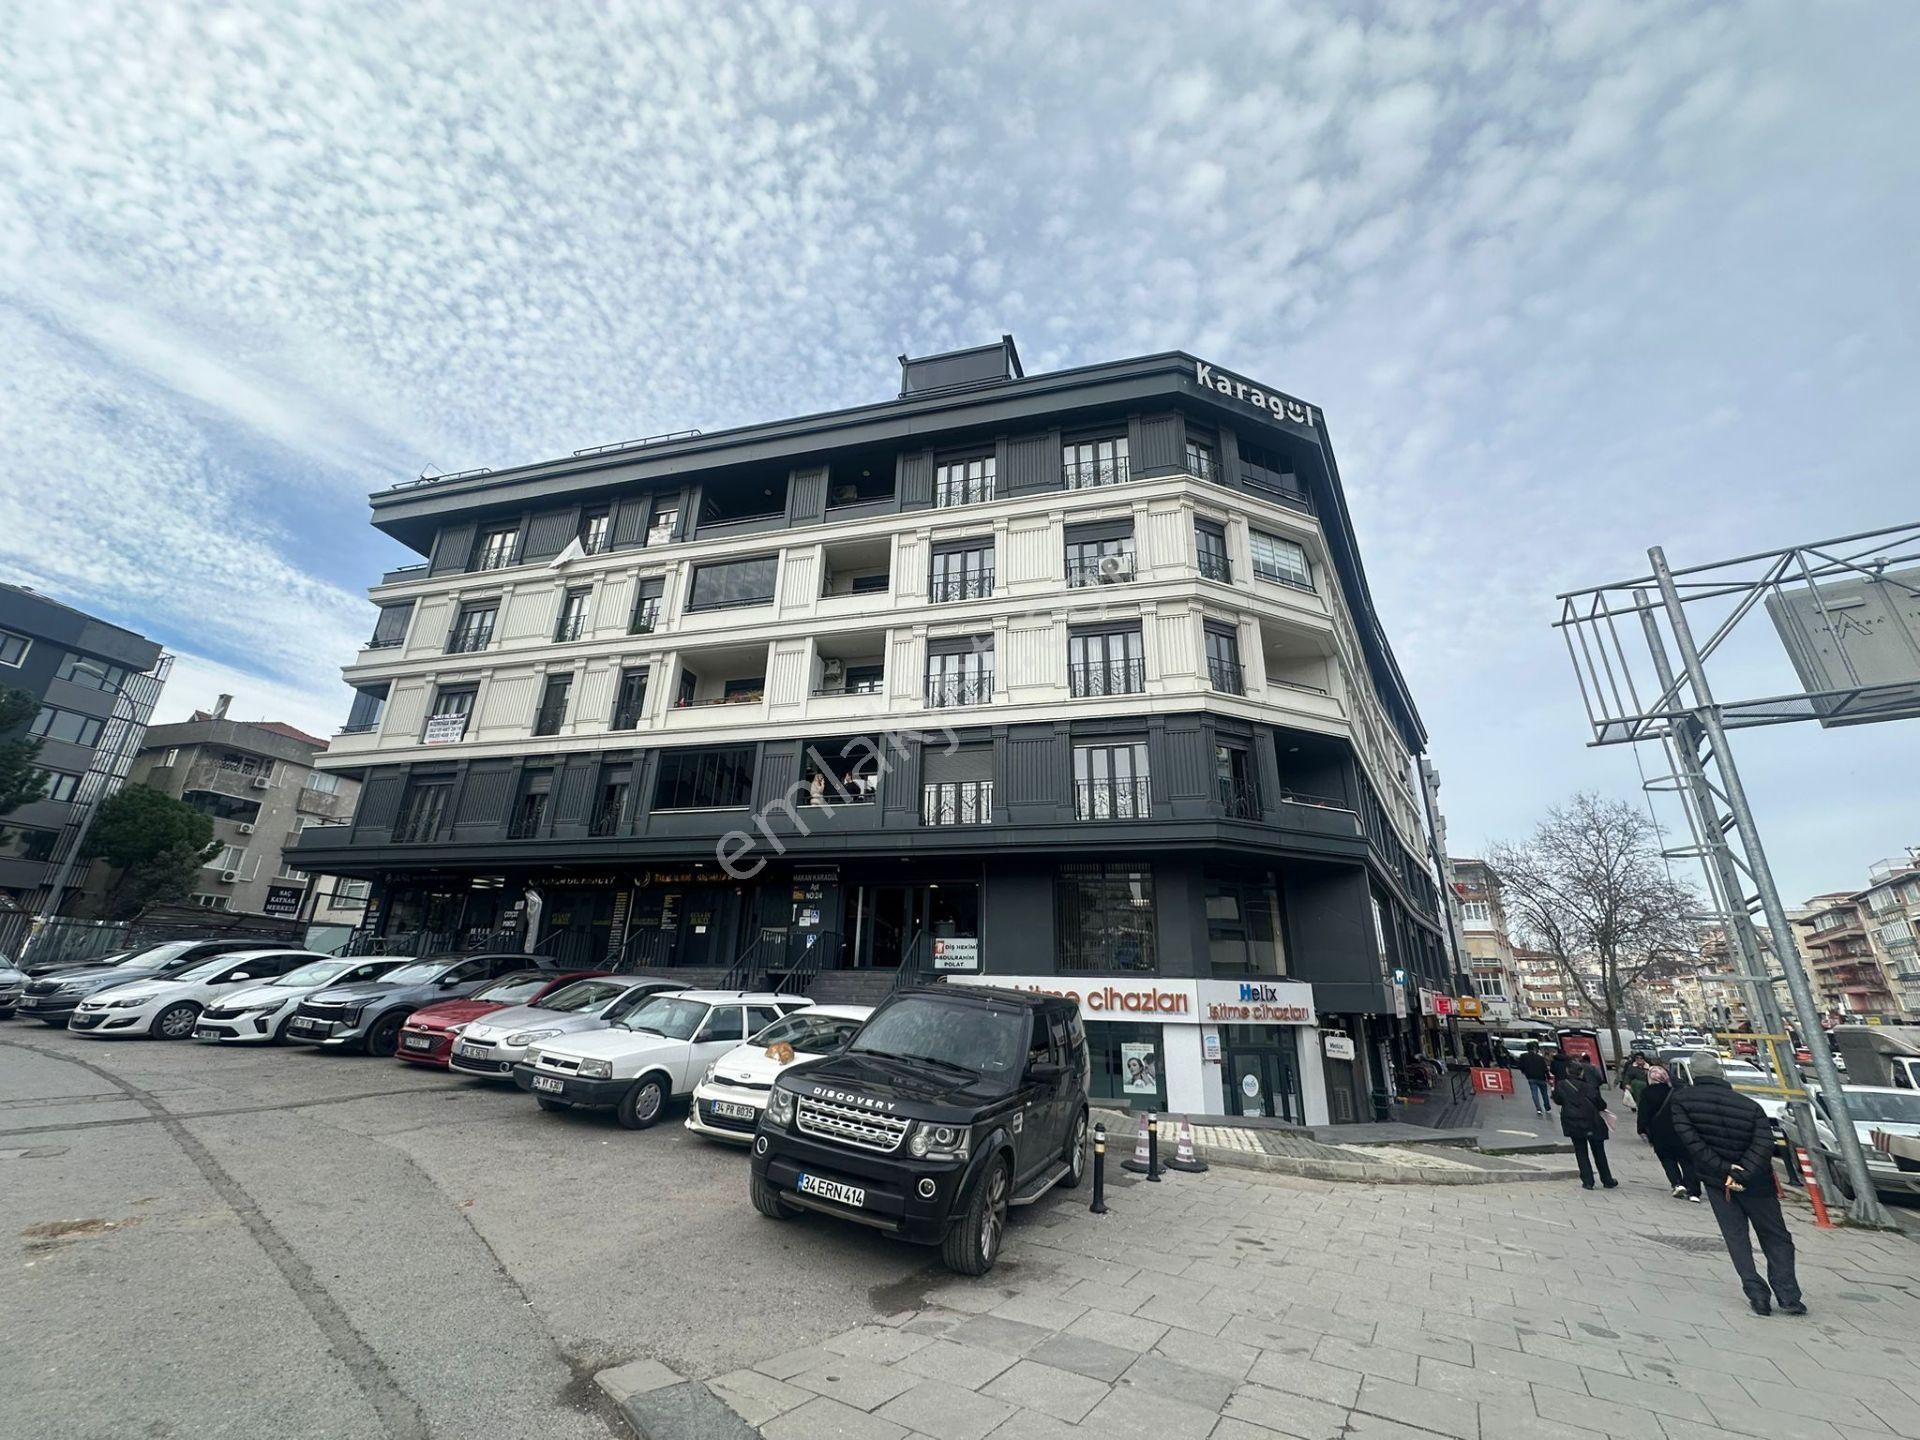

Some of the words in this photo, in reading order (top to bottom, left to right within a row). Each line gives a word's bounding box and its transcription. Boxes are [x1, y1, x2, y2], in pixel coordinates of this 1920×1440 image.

[1196, 361, 1314, 428] Karagül
[1087, 986, 1189, 1013] cihazları
[1239, 984, 1278, 1002] Helix
[1484, 1074, 1499, 1089] E
[716, 1102, 724, 1112] 34
[813, 1086, 896, 1111] DISCOVERY
[803, 1176, 816, 1192] 34
[817, 1180, 842, 1200] ERN
[843, 1187, 863, 1206] 414
